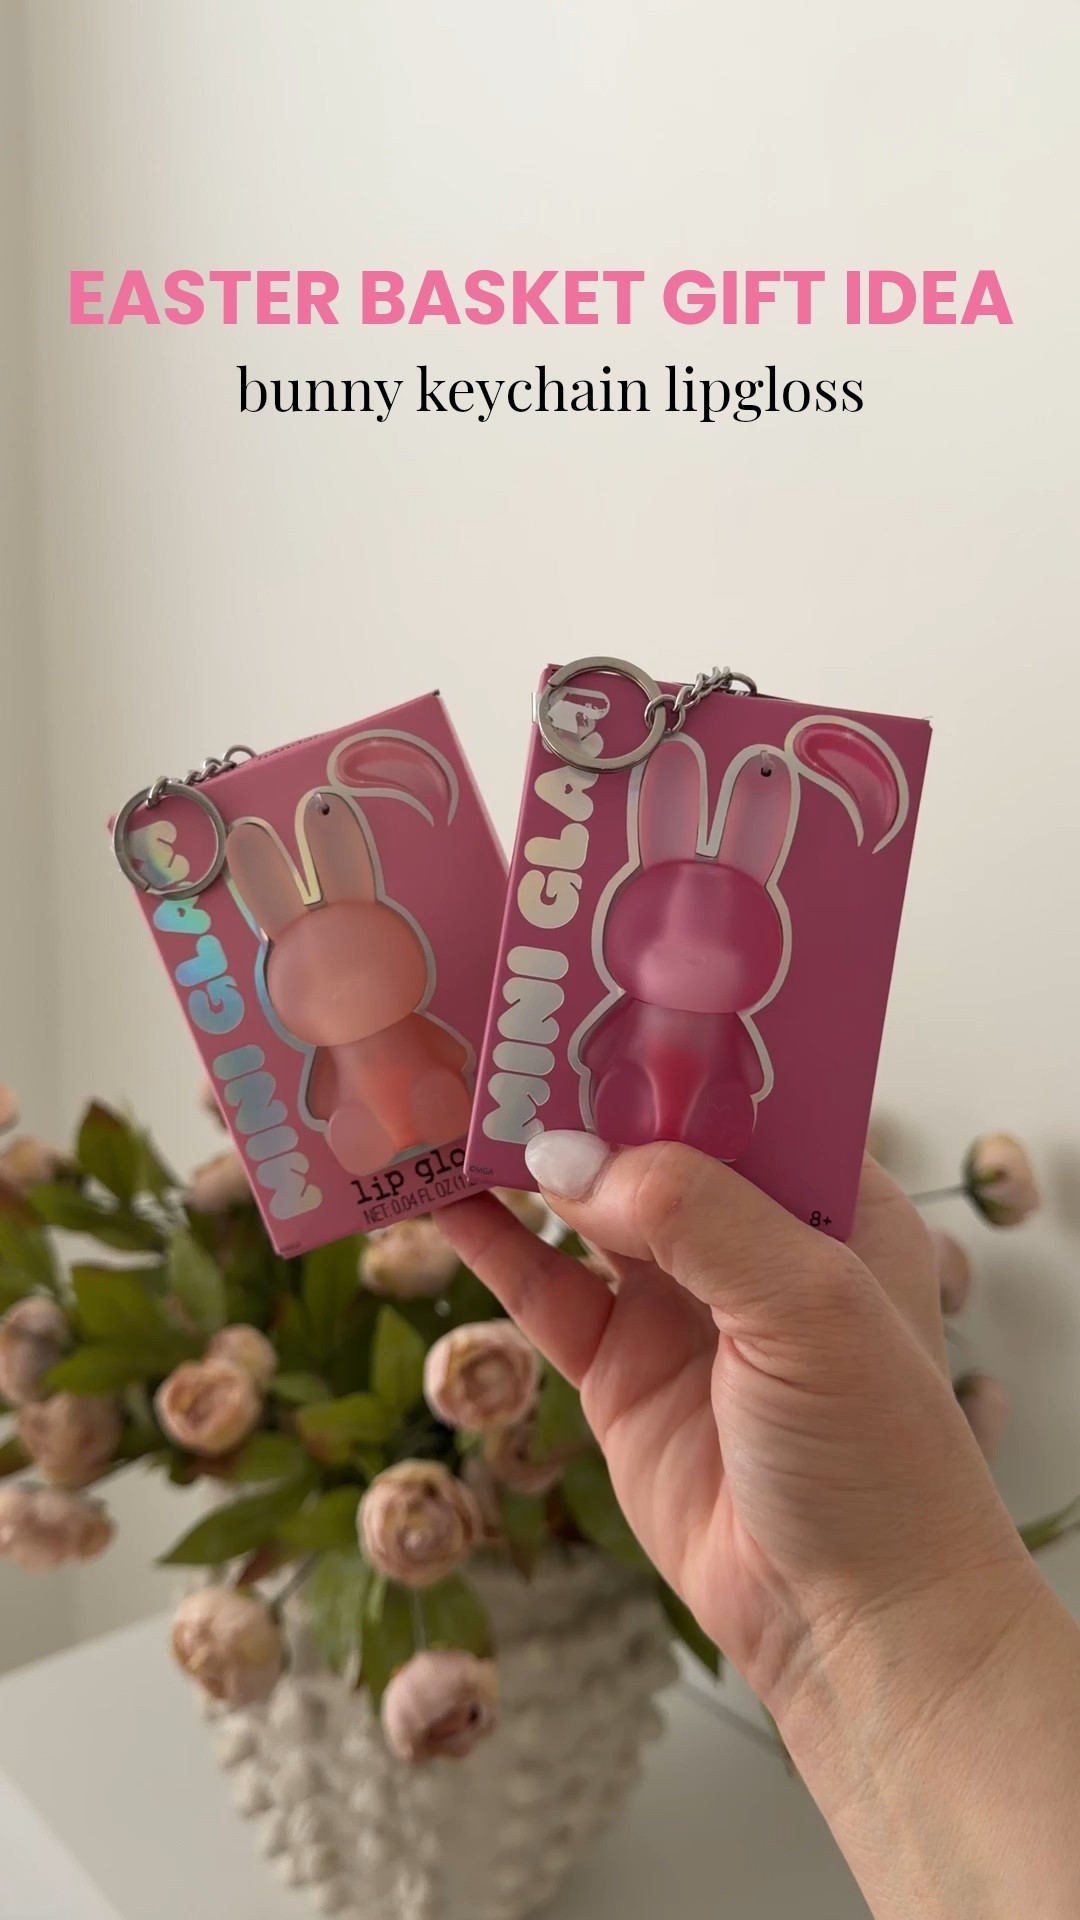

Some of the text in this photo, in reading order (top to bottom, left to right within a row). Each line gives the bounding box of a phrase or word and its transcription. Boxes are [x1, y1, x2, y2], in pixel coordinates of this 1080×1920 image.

[482, 945, 569, 1145] MINI
[212, 1044, 323, 1221] MINI
[351, 1170, 405, 1205] lip
[391, 1192, 418, 1214] 0.04
[434, 1179, 455, 1198] OZ
[810, 1210, 832, 1227] 8+
